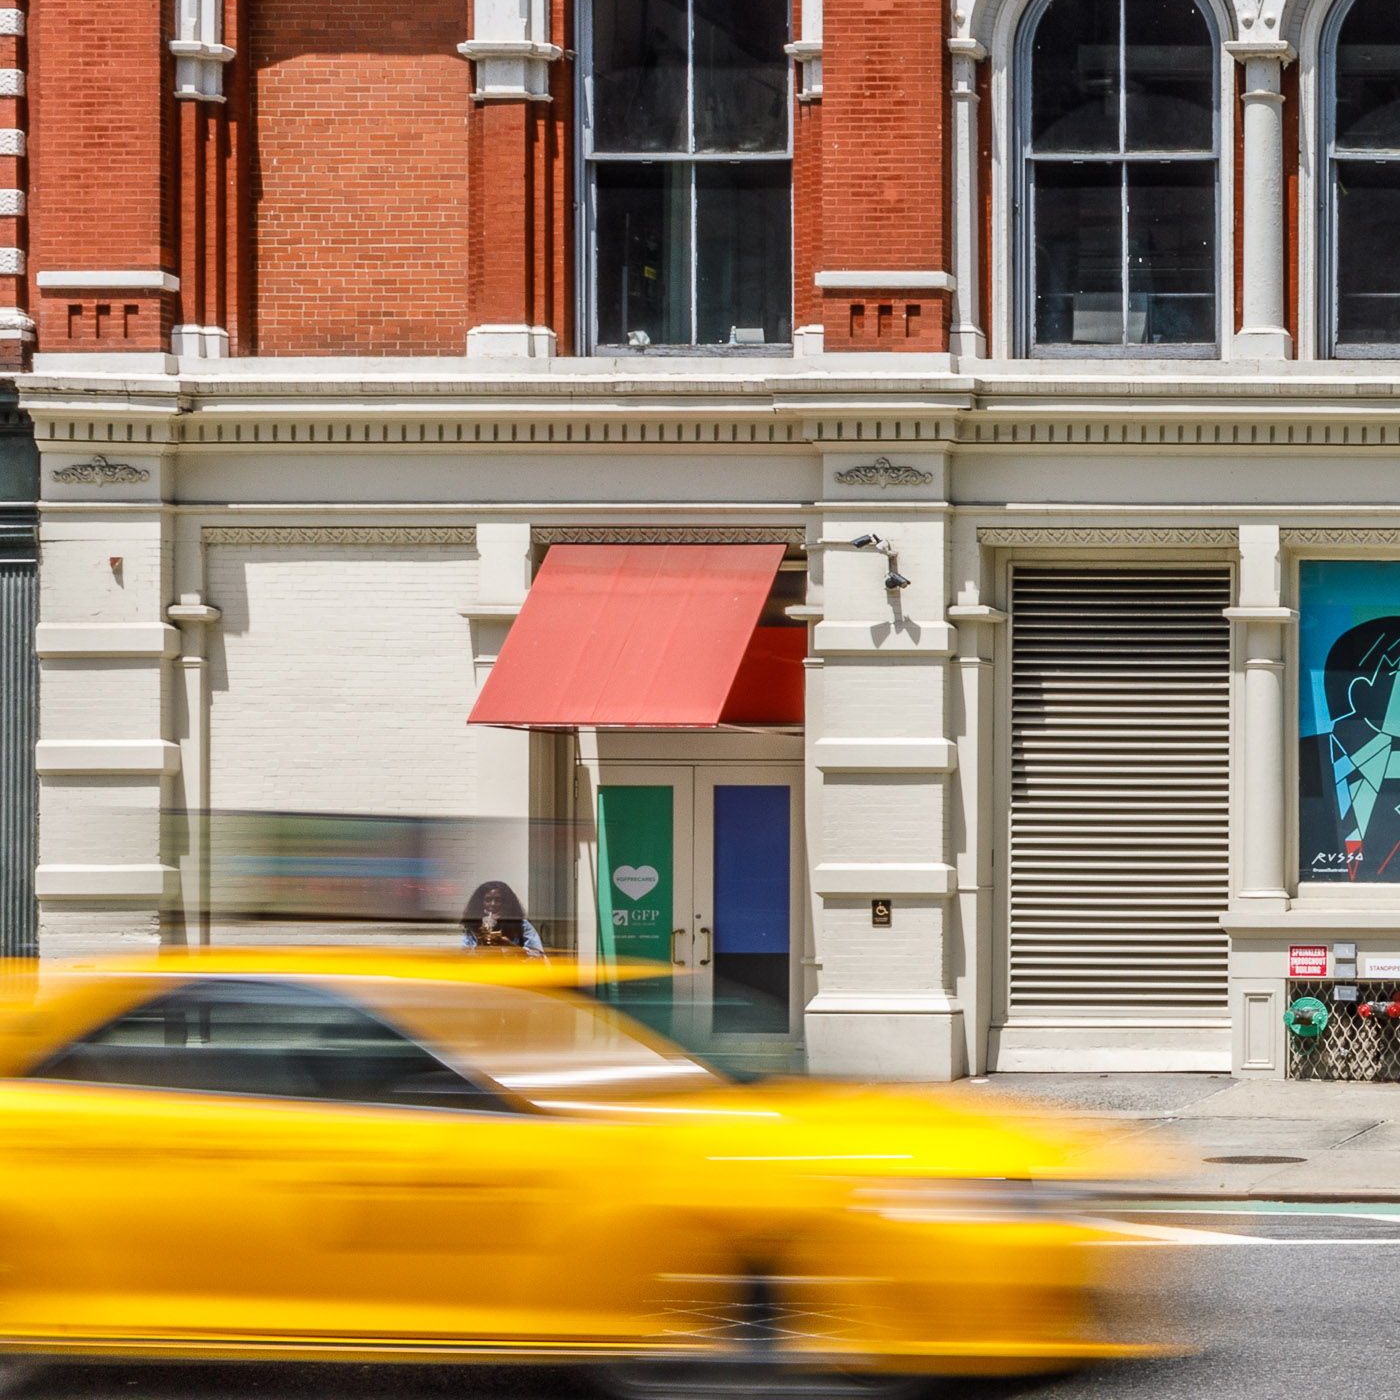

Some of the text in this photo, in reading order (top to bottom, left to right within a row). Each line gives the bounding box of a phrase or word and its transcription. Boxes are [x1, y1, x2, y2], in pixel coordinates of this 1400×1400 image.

[631, 909, 660, 921] GFP
[1291, 948, 1325, 957] SPRINKLERS
[1290, 957, 1326, 966] THROUGHOUT
[1295, 965, 1322, 974] BUILDING
[1369, 964, 1400, 972] STANDPIPE
